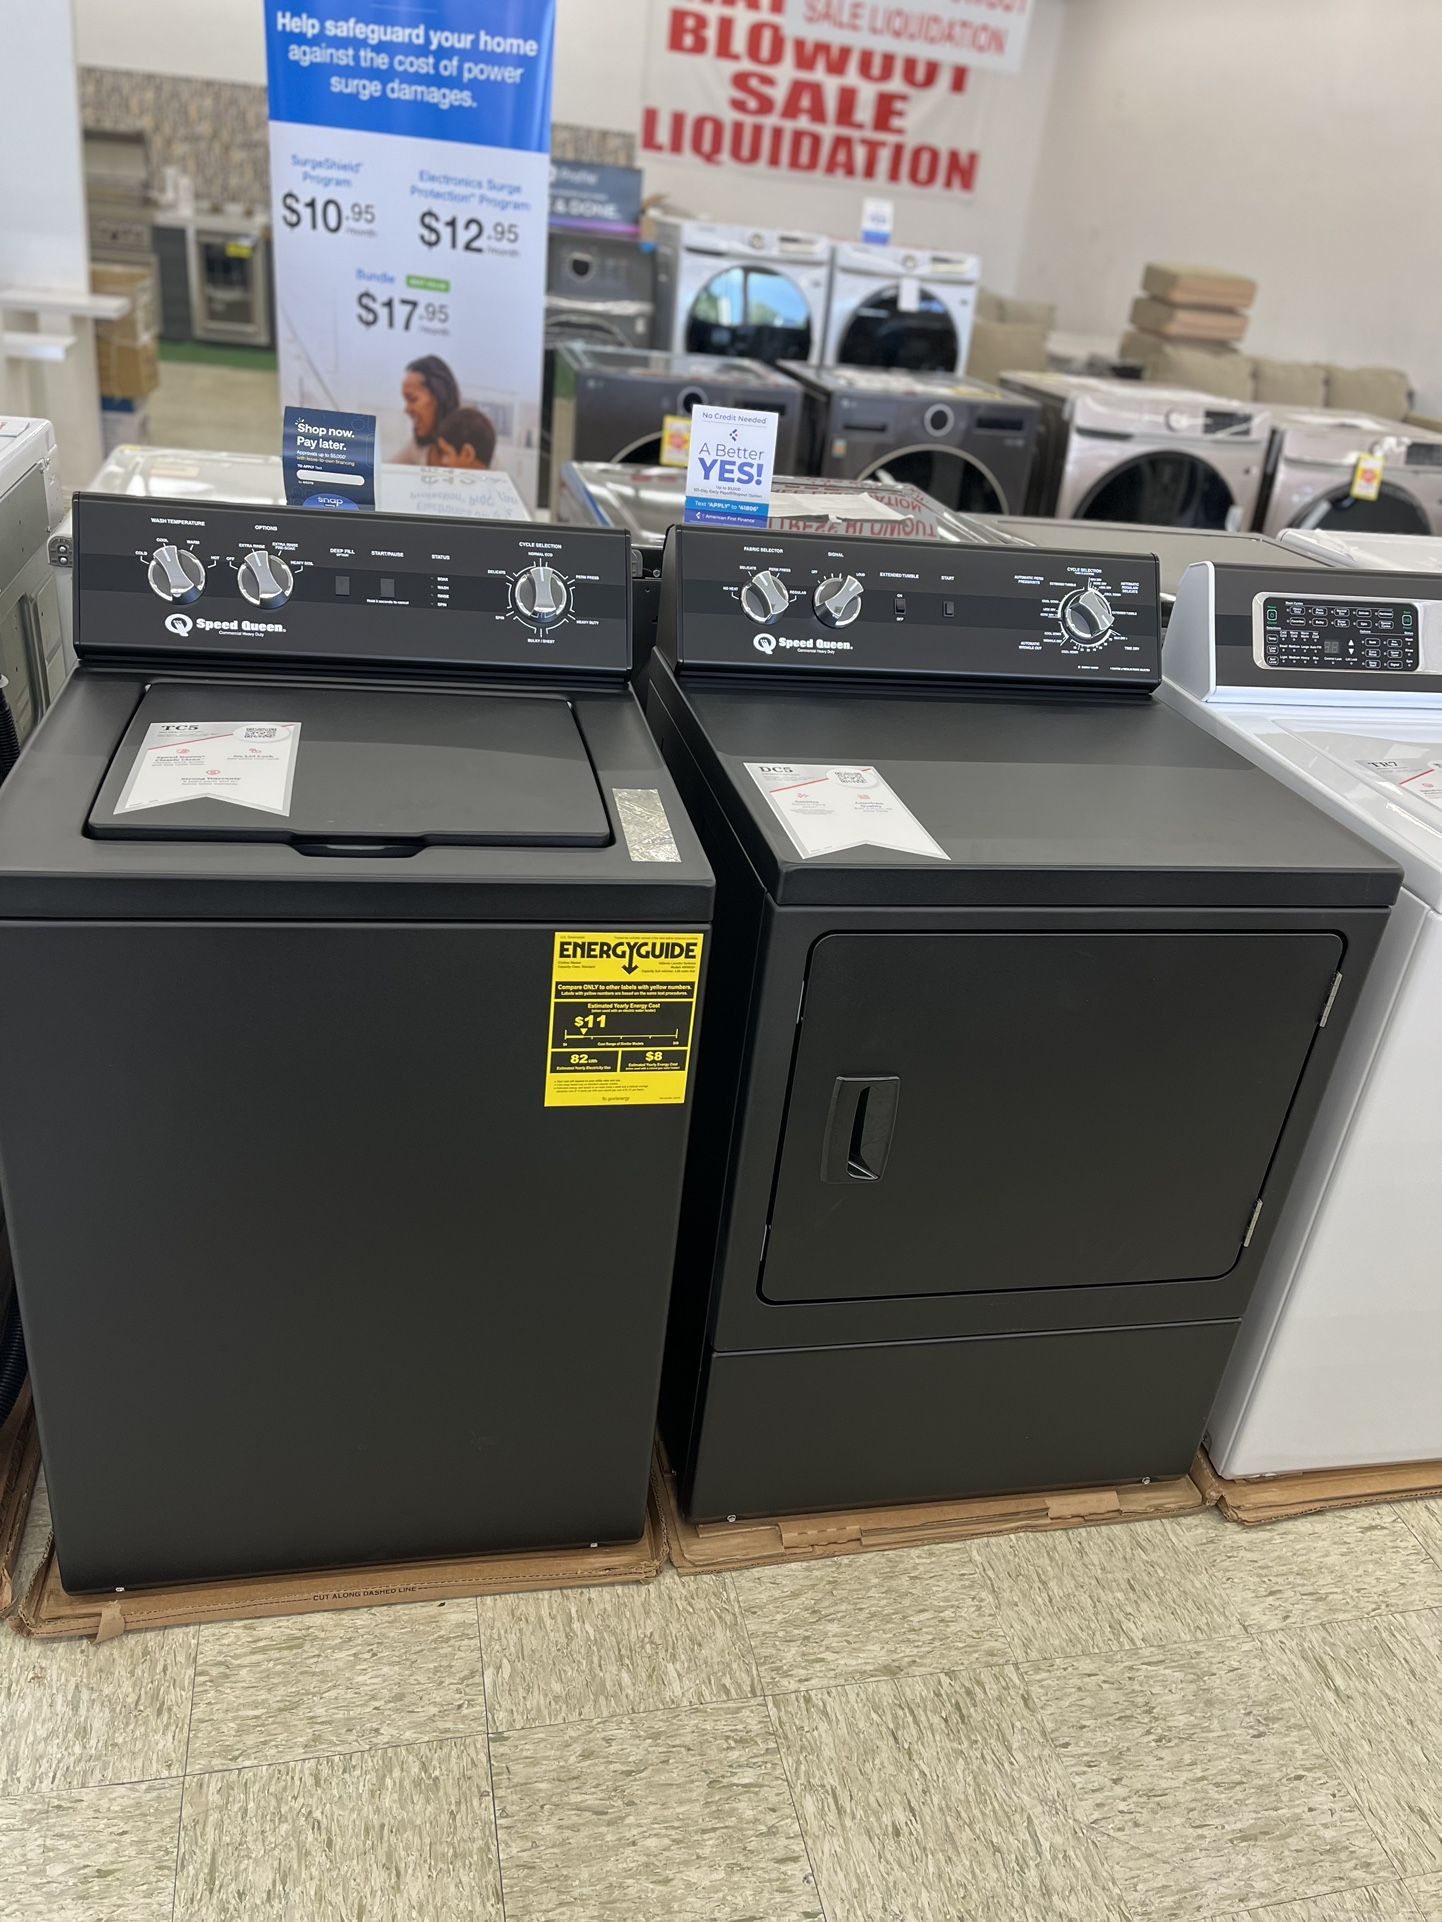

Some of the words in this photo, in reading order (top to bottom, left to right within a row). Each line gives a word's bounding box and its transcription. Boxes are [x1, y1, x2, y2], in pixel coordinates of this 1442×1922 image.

[277, 11, 320, 38] Help
[324, 17, 425, 45] safeguard
[428, 29, 475, 51] your
[479, 29, 538, 57] home
[803, 0, 863, 32] SALE
[868, 4, 1008, 54] LIQUIDATION
[667, 8, 970, 93] BLOWOUT
[288, 43, 355, 67] against
[359, 47, 390, 70] the
[393, 54, 435, 75] cost
[439, 55, 459, 77] of
[462, 61, 525, 84] power
[330, 76, 383, 101] surge
[386, 78, 478, 110] damages.
[729, 71, 909, 134] SALE
[642, 107, 980, 192] LIQUIDATION
[419, 170, 483, 190] Electronics
[487, 179, 523, 196] Surge
[479, 194, 532, 212] Program
[714, 412, 737, 422] Credit
[738, 415, 767, 424] Needed
[297, 423, 327, 437] Shop
[328, 428, 355, 438] now.
[297, 436, 318, 450] Pay
[319, 438, 347, 451] later.
[698, 442, 711, 456] A
[715, 443, 765, 461] Better
[697, 457, 764, 486] YES!
[167, 518, 206, 527] TEMPERATURE
[371, 550, 405, 558] START/PAUSE
[196, 618, 239, 631] Speed
[778, 637, 814, 649] Speed
[559, 941, 698, 959] ENERGYGUIDE
[613, 1002, 629, 1010] Yearly
[629, 1002, 648, 1010] Energy
[574, 1014, 606, 1028] $11
[570, 1054, 588, 1064] 82
[645, 1051, 663, 1062] $8
[331, 1591, 361, 1600] ALONG
[363, 1588, 397, 1597] DASHED
